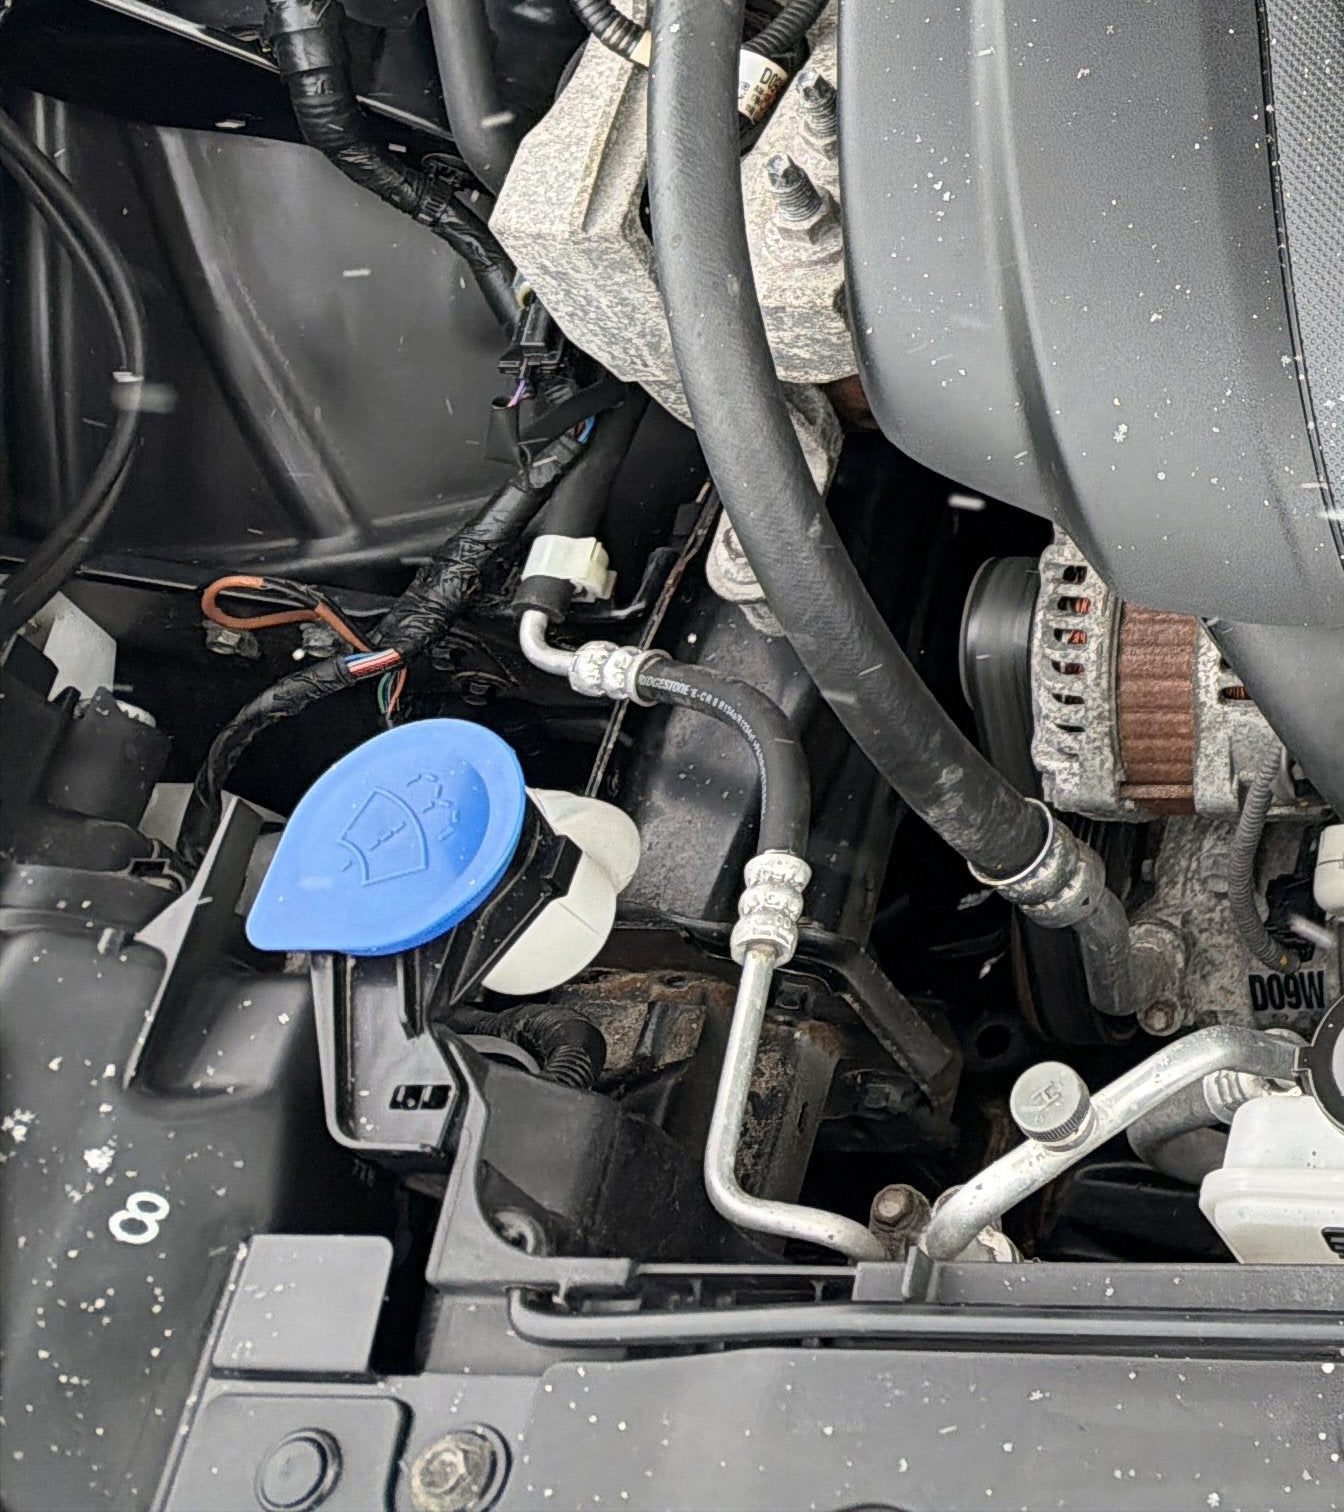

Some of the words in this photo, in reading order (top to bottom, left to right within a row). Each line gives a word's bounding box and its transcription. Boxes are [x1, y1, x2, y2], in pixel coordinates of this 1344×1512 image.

[637, 674, 691, 696] RIDGESTONE
[1247, 970, 1326, 1012] D09W
[108, 1191, 170, 1244] 8
